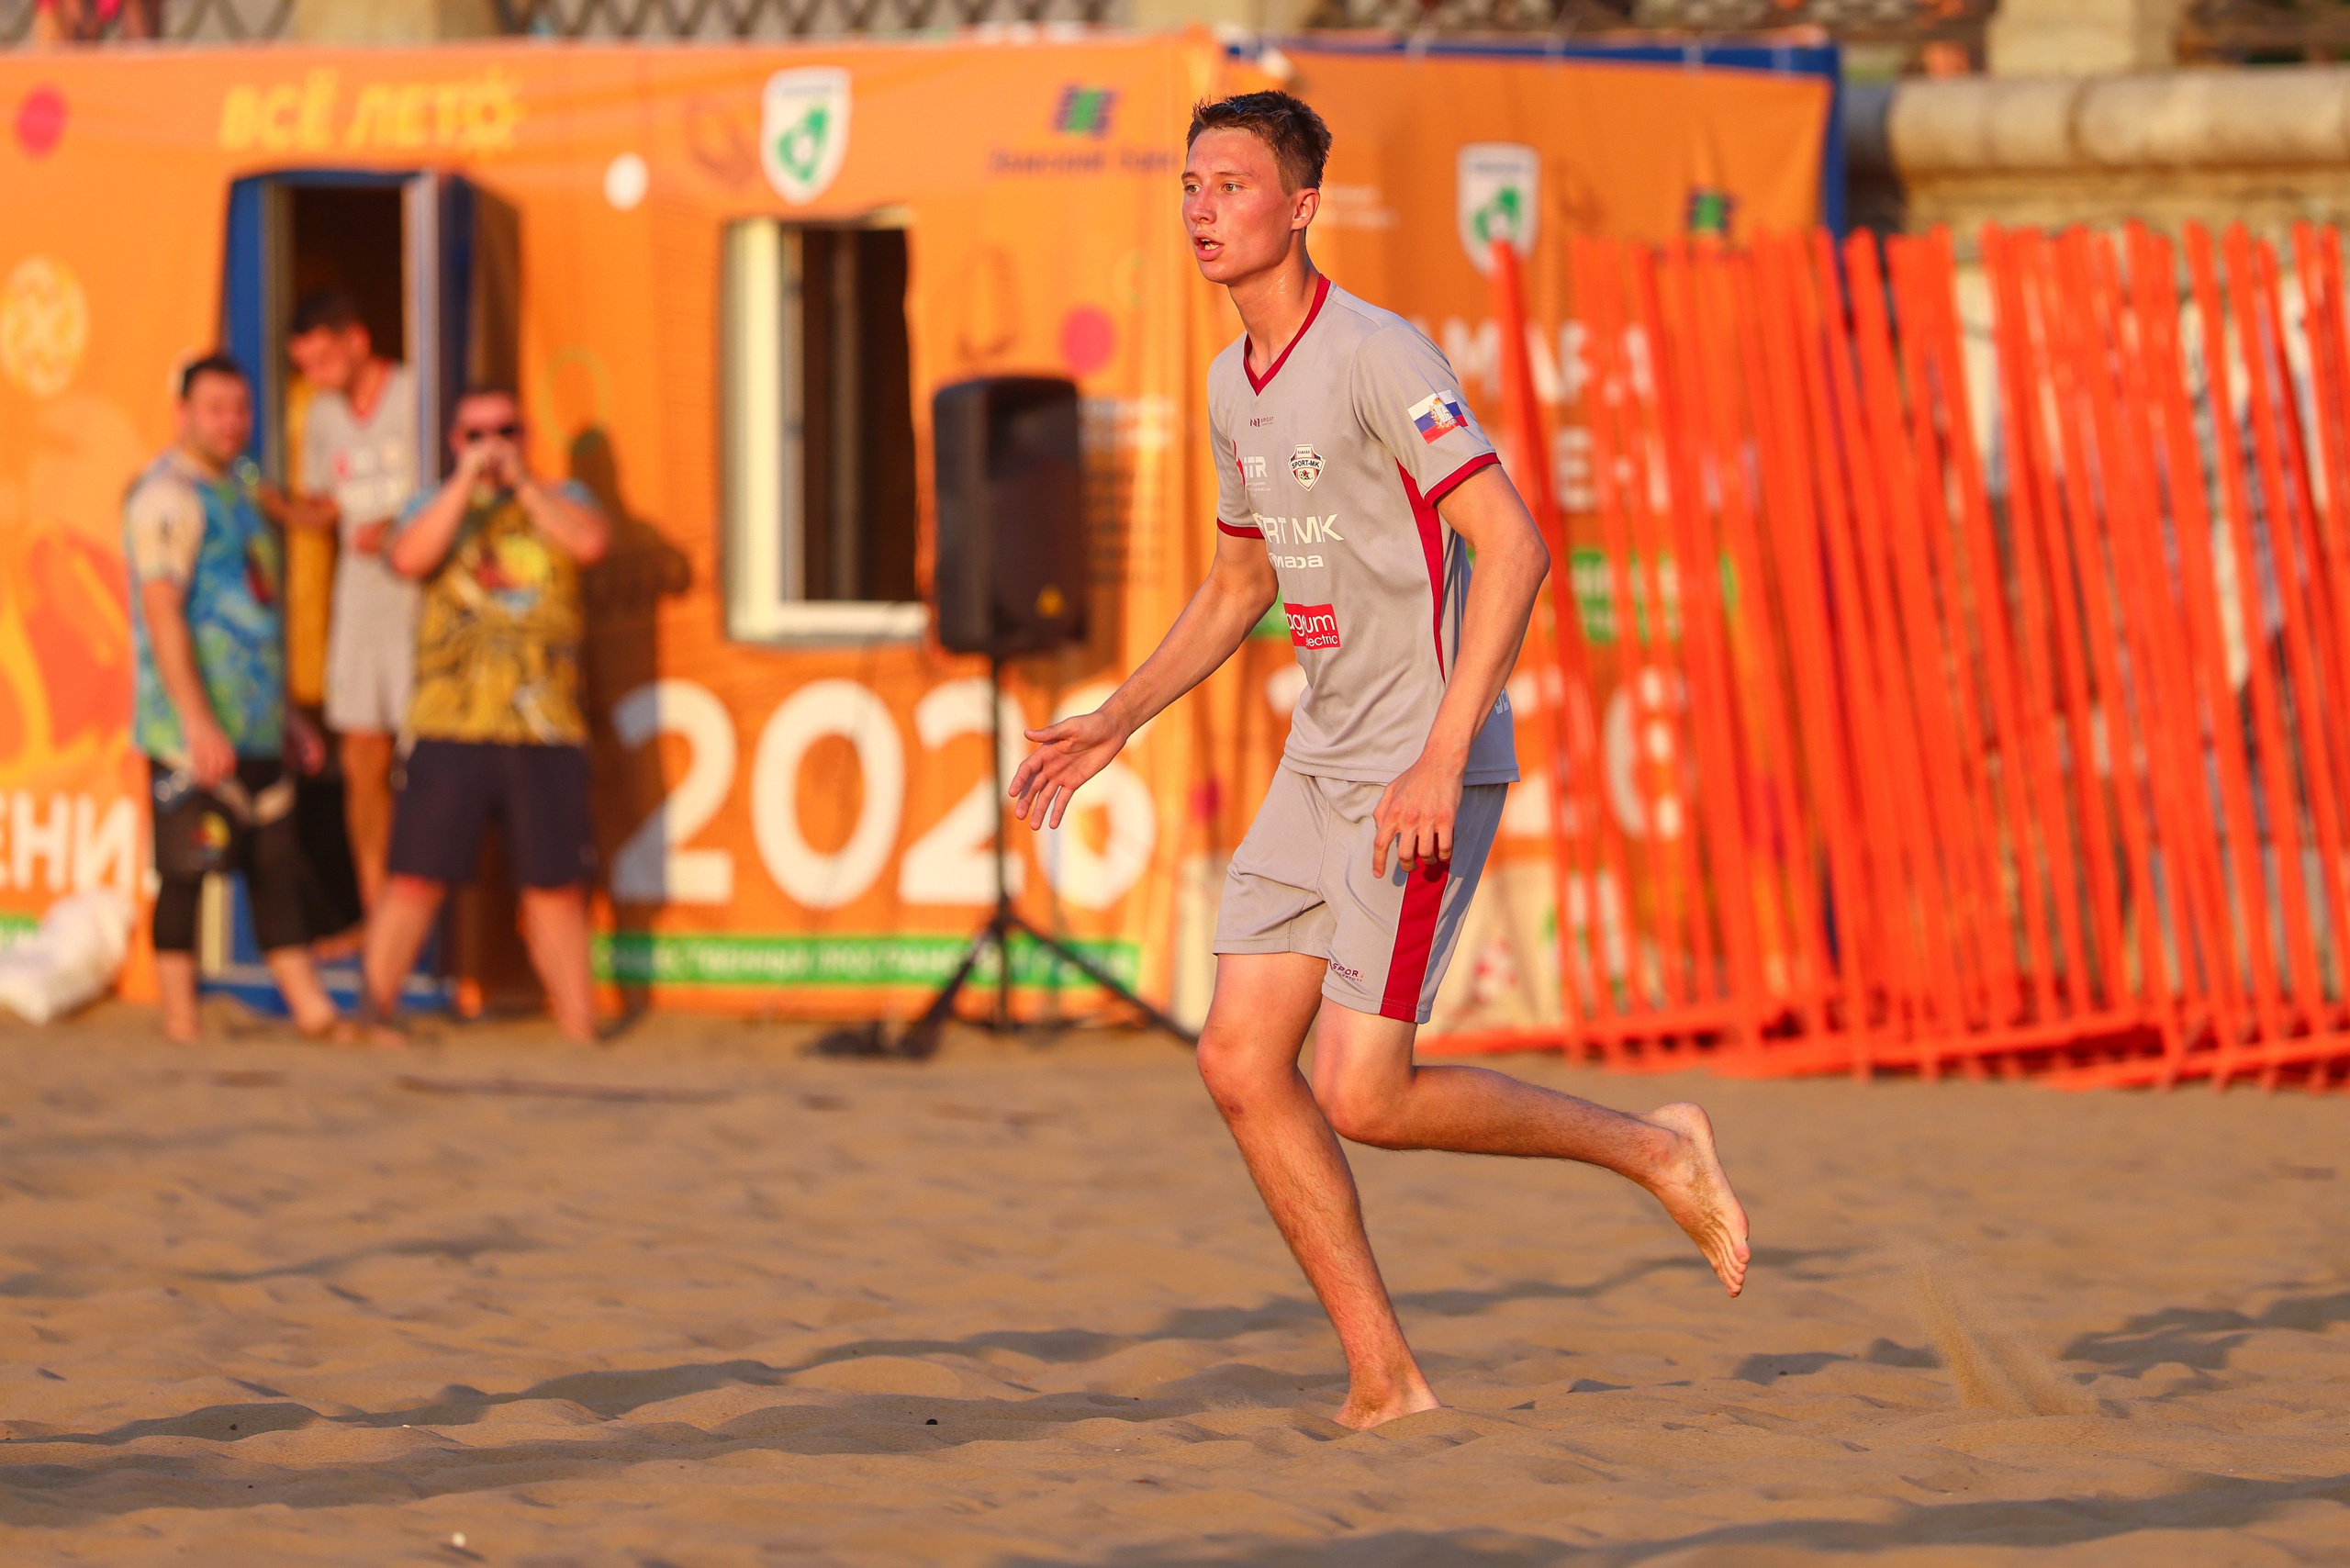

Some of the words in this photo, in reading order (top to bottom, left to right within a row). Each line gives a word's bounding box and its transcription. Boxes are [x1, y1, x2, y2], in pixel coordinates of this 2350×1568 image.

[1292, 459, 1320, 469] SPORT-MK
[1291, 513, 1345, 545] MK
[610, 678, 1157, 911] 2026
